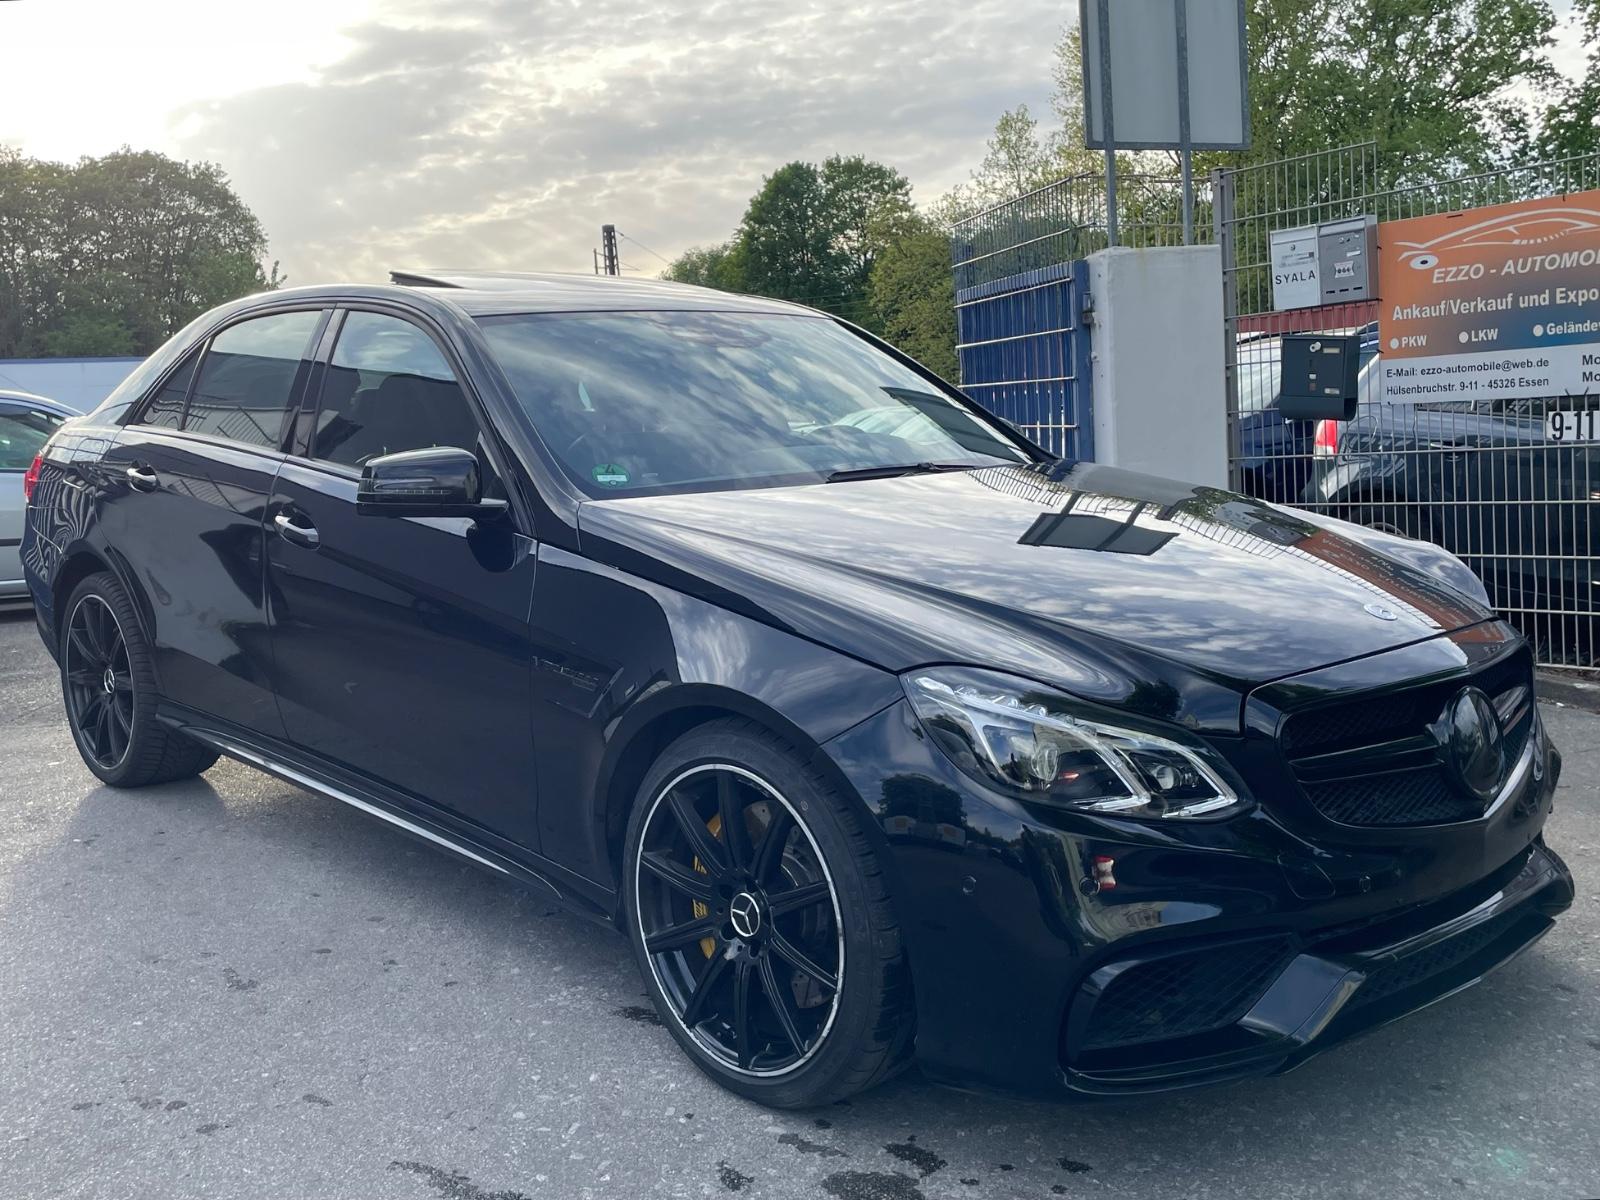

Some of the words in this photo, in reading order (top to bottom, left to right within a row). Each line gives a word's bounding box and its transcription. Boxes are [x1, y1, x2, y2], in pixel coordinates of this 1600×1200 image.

[1275, 269, 1316, 285] SYALA
[1432, 264, 1484, 284] EZZO
[1392, 293, 1513, 321] Ankauf/Verkauf
[1519, 289, 1550, 308] und
[1401, 335, 1427, 348] PKW
[1471, 328, 1499, 342] LKW
[1386, 367, 1418, 378] E-Mail:
[1420, 358, 1550, 376] ezzo-automobile@web.de
[1386, 381, 1457, 396] Hülsenbruchstr.
[1459, 381, 1478, 391] 9-11
[1487, 378, 1516, 389] 45326
[1518, 376, 1549, 387] Essen
[1551, 411, 1594, 441] 9-11
